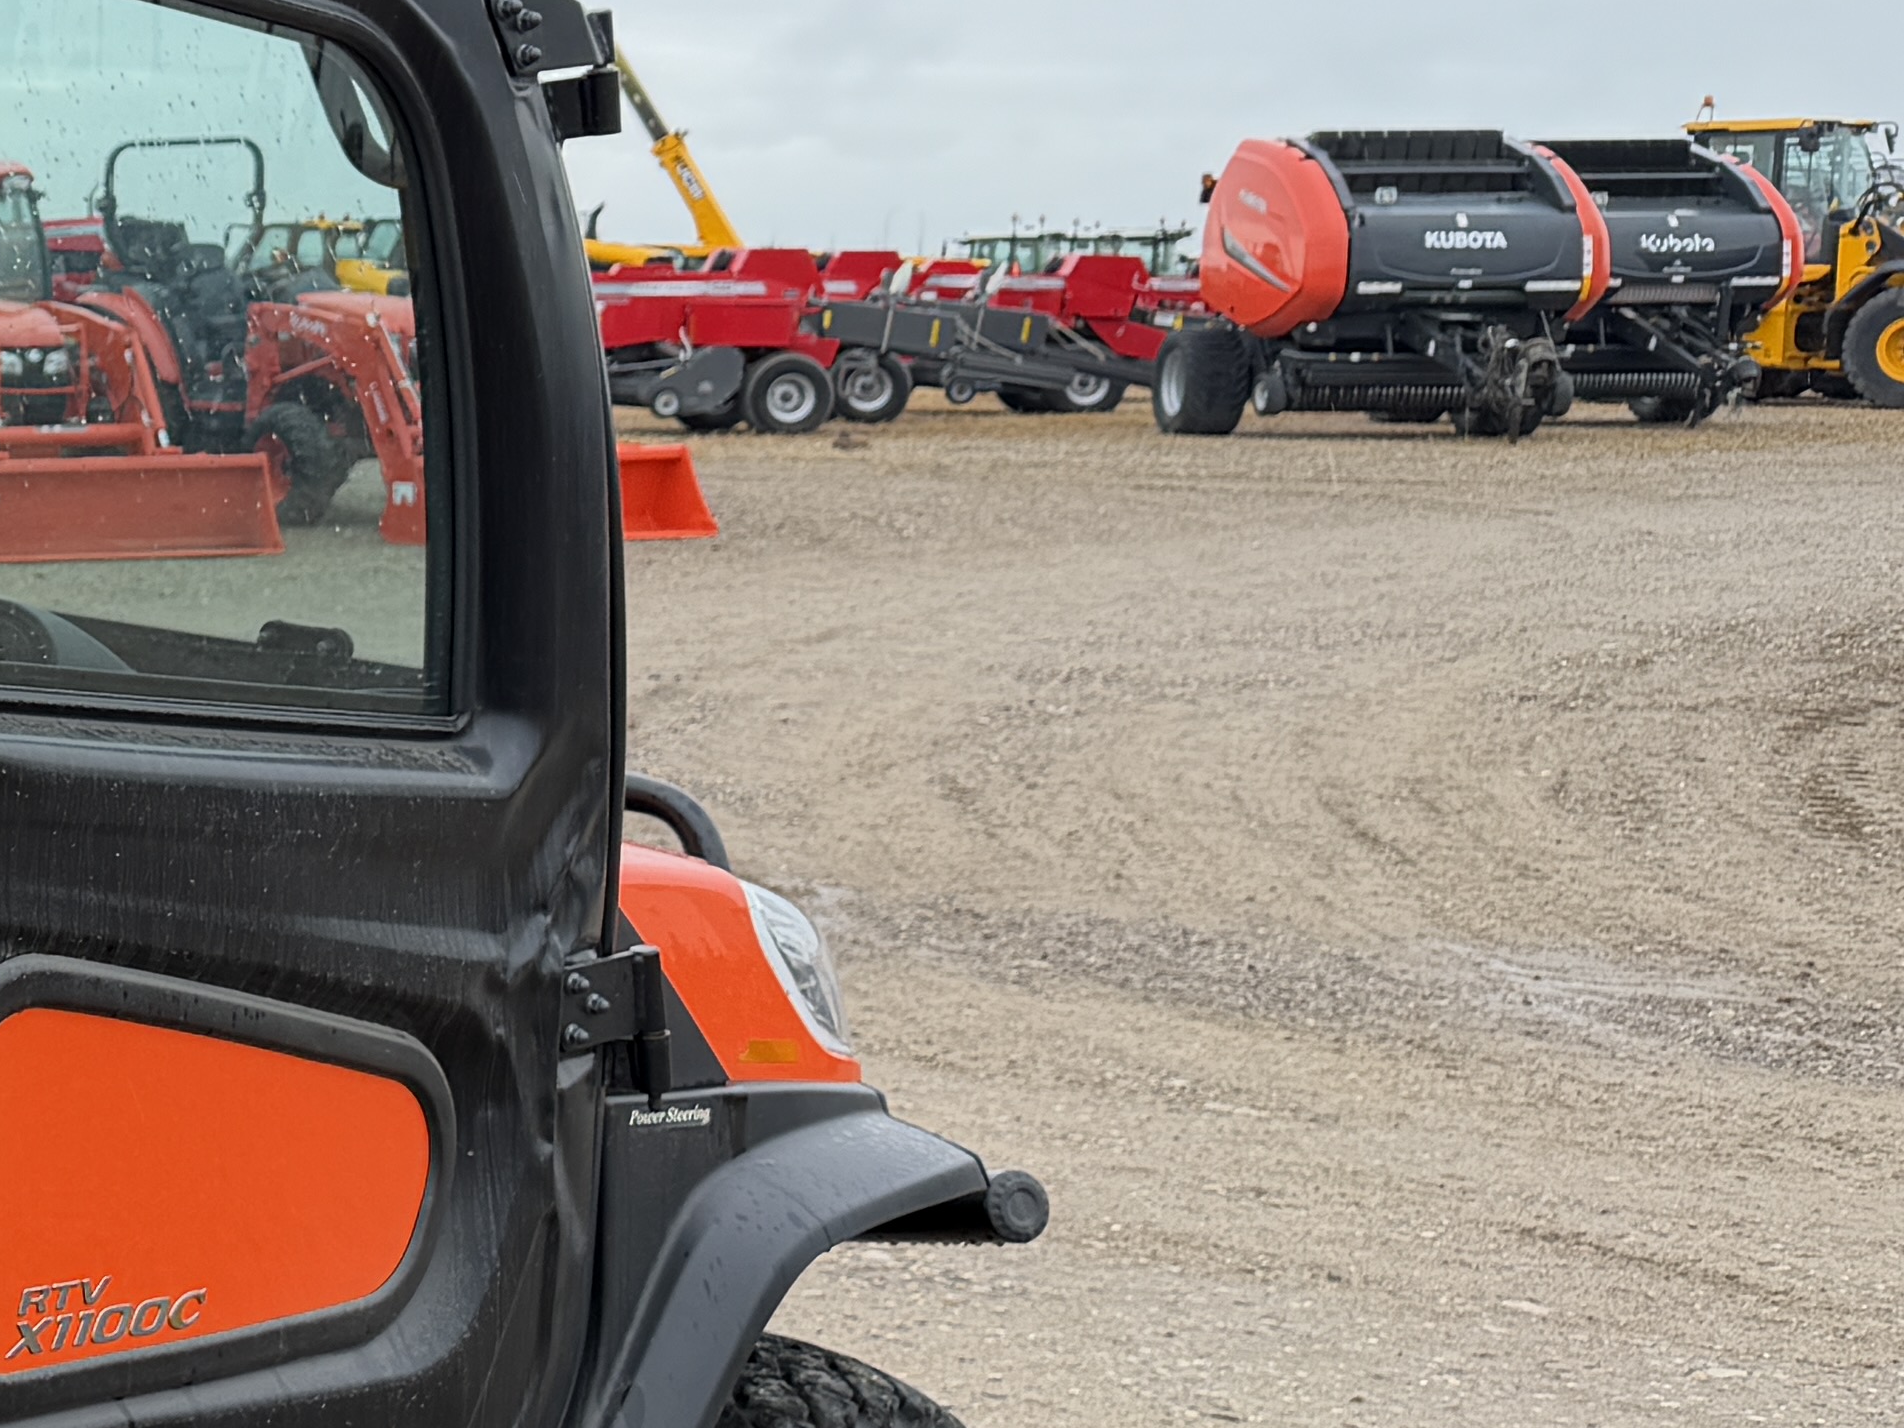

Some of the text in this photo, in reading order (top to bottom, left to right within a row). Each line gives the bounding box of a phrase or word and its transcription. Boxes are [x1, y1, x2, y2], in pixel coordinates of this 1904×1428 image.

[1424, 230, 1508, 249] KUBOTA
[1640, 233, 1715, 253] Kubota
[628, 1103, 711, 1126] Power Steering
[17, 1274, 113, 1317] RTV
[4, 1287, 208, 1360] X1100C
